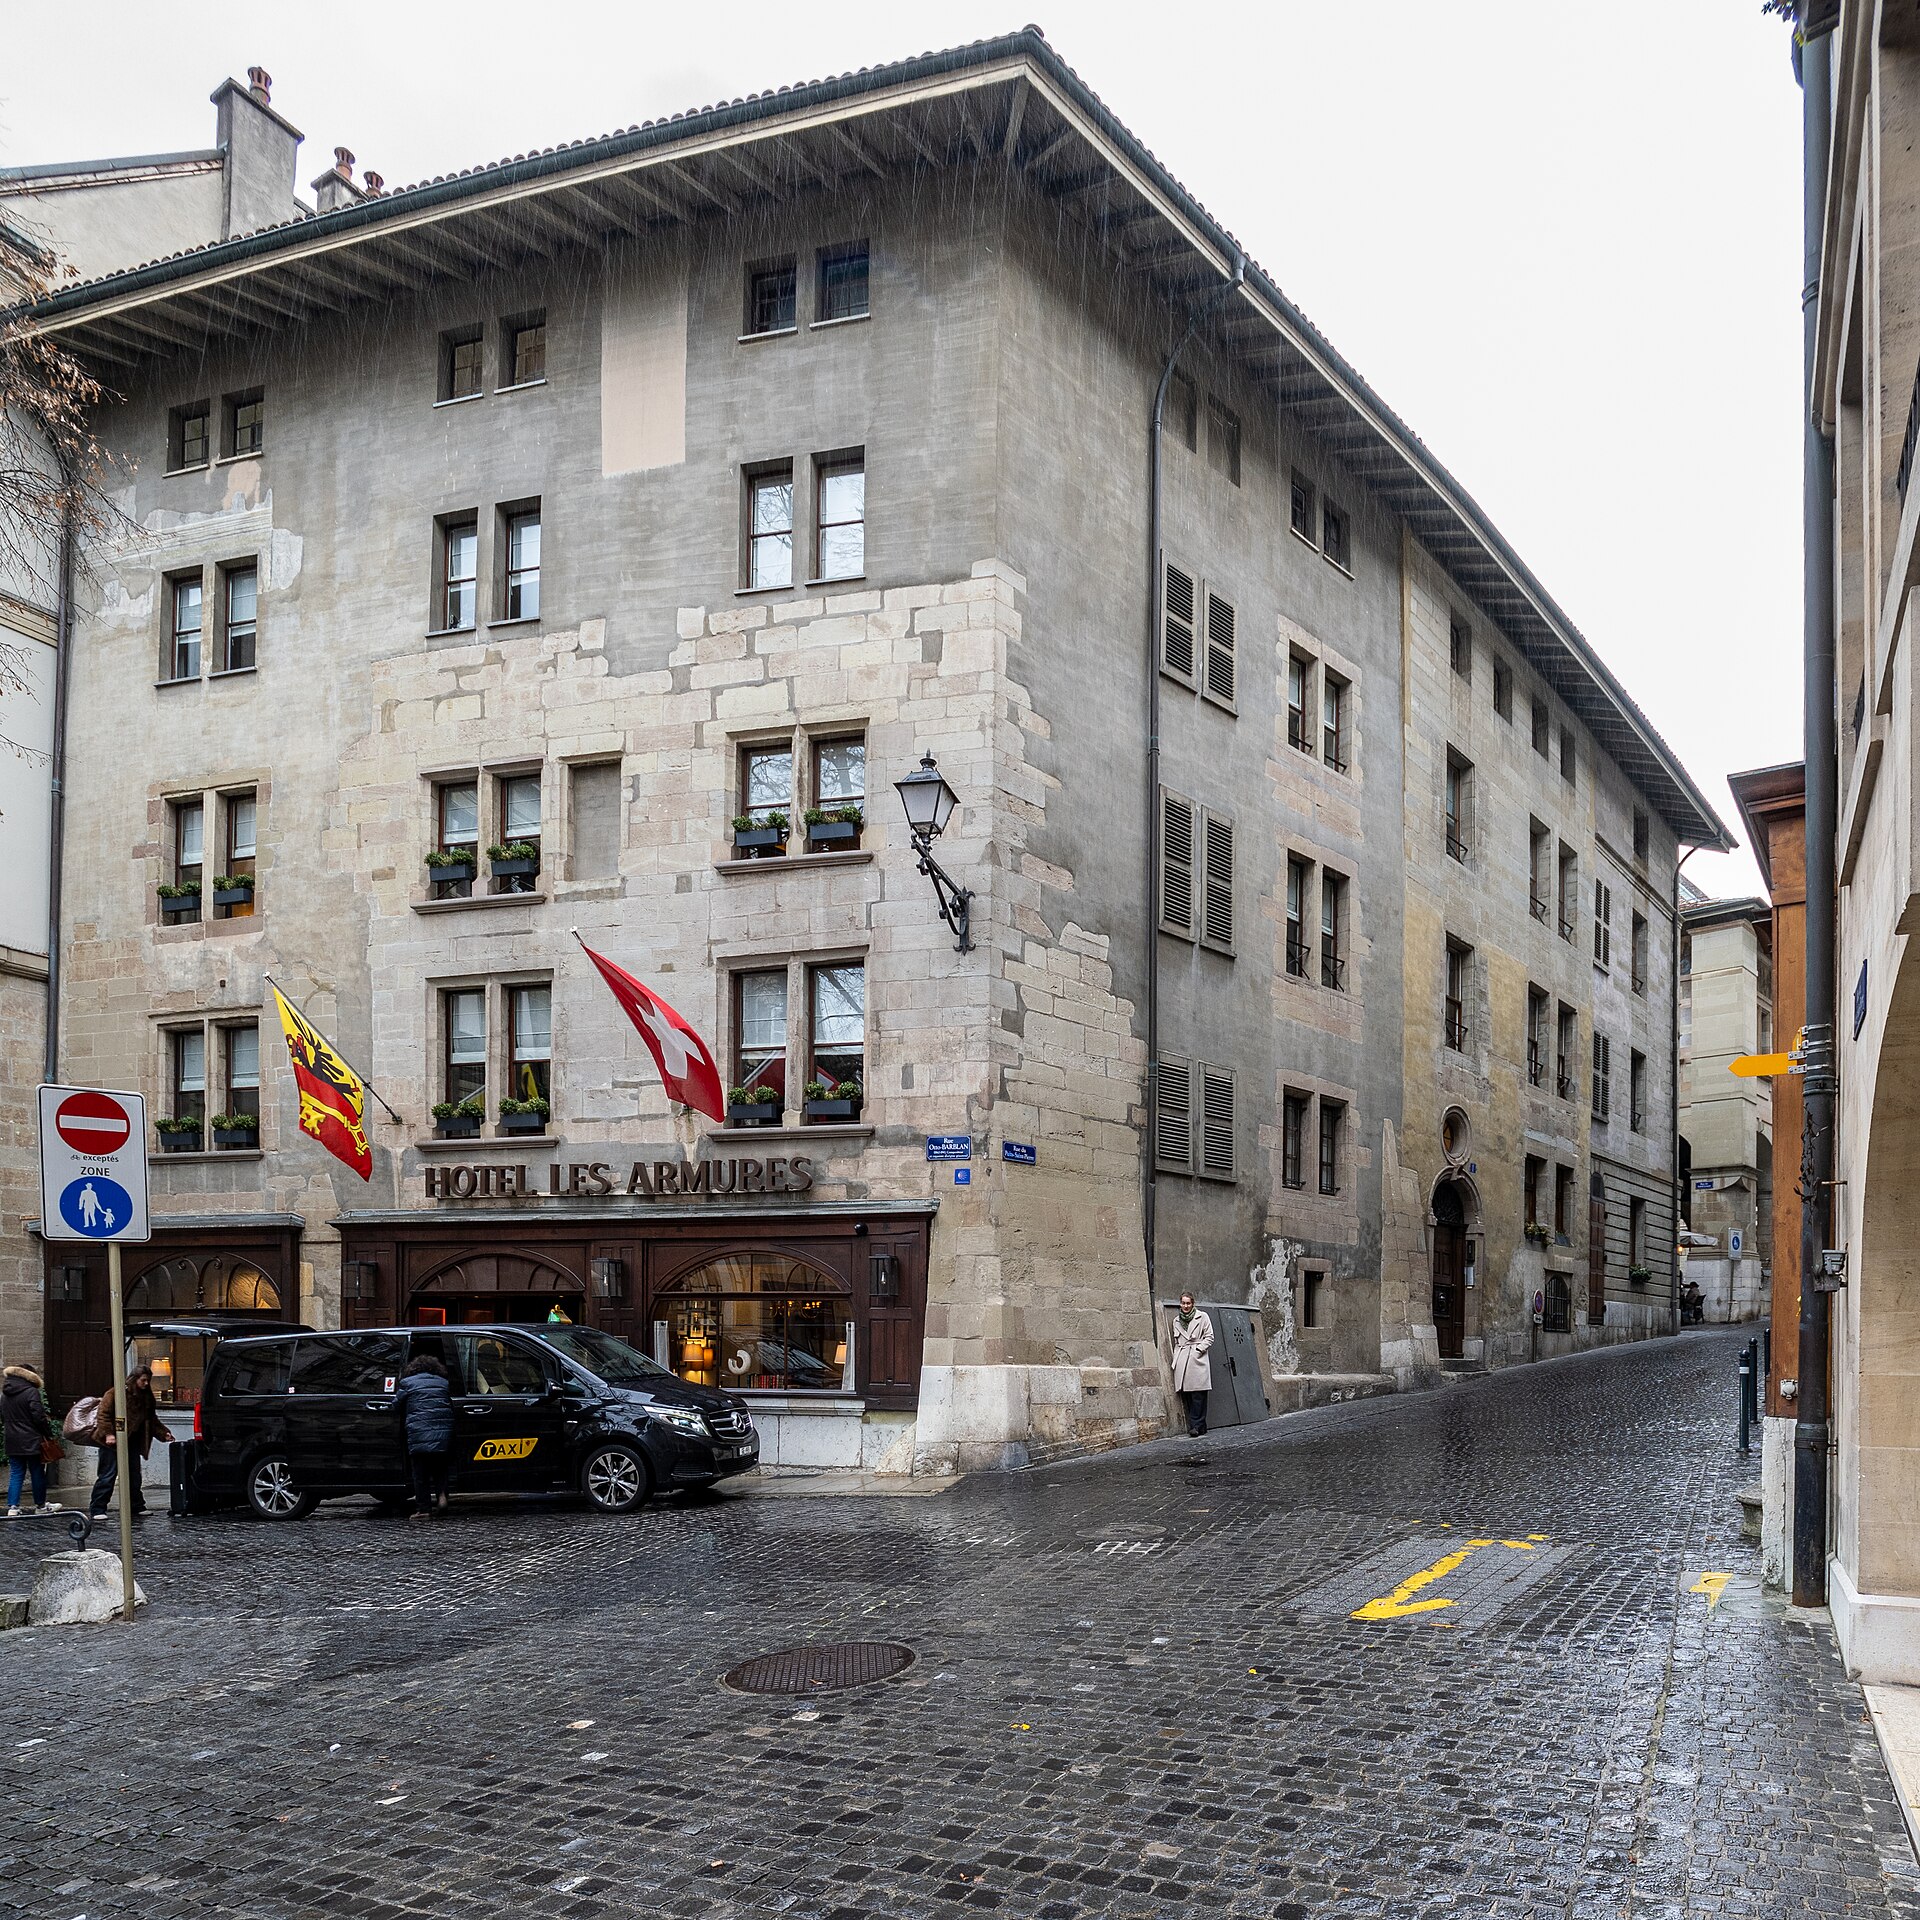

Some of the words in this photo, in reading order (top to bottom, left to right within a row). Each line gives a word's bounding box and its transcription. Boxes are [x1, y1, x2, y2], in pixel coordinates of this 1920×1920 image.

[82, 1155, 120, 1163] exceptés
[80, 1166, 111, 1177] ZONE
[425, 1165, 538, 1198] HOTEL
[549, 1162, 613, 1197] LES
[626, 1156, 813, 1195] ARMURES
[482, 1442, 523, 1457] TAXI
